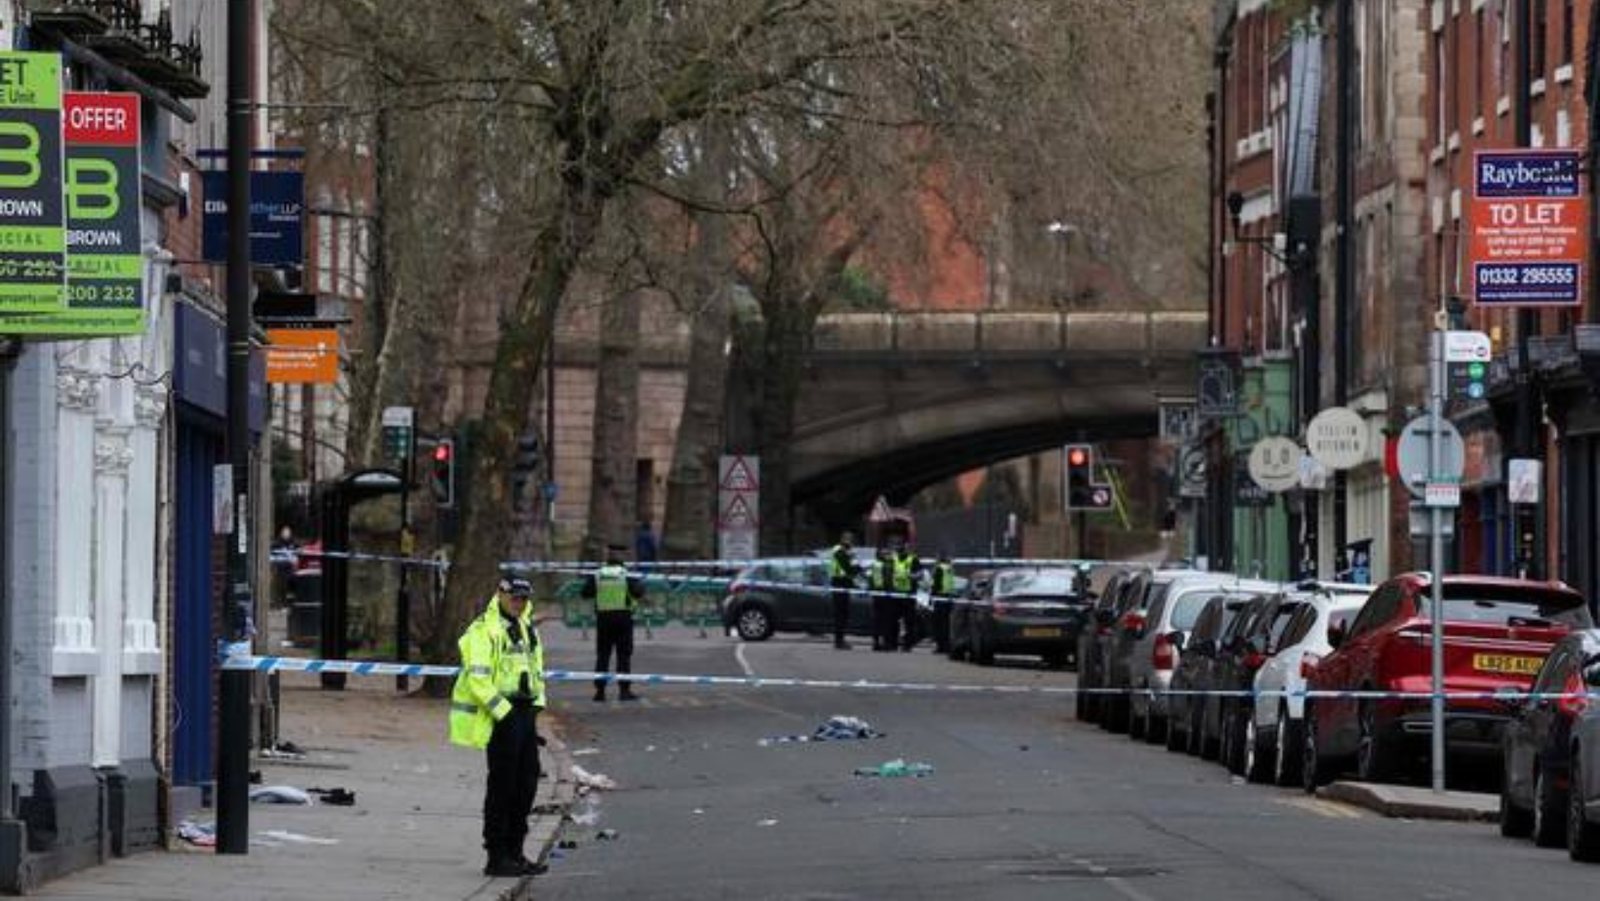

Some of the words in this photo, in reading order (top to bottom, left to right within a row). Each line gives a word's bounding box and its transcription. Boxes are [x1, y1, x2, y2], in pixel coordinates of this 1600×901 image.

[70, 107, 127, 131] OFFER
[1489, 203, 1518, 225] TO
[1524, 203, 1565, 225] LET
[1479, 267, 1518, 285] 01332
[1521, 267, 1575, 285] 295555
[102, 286, 136, 302] 232
